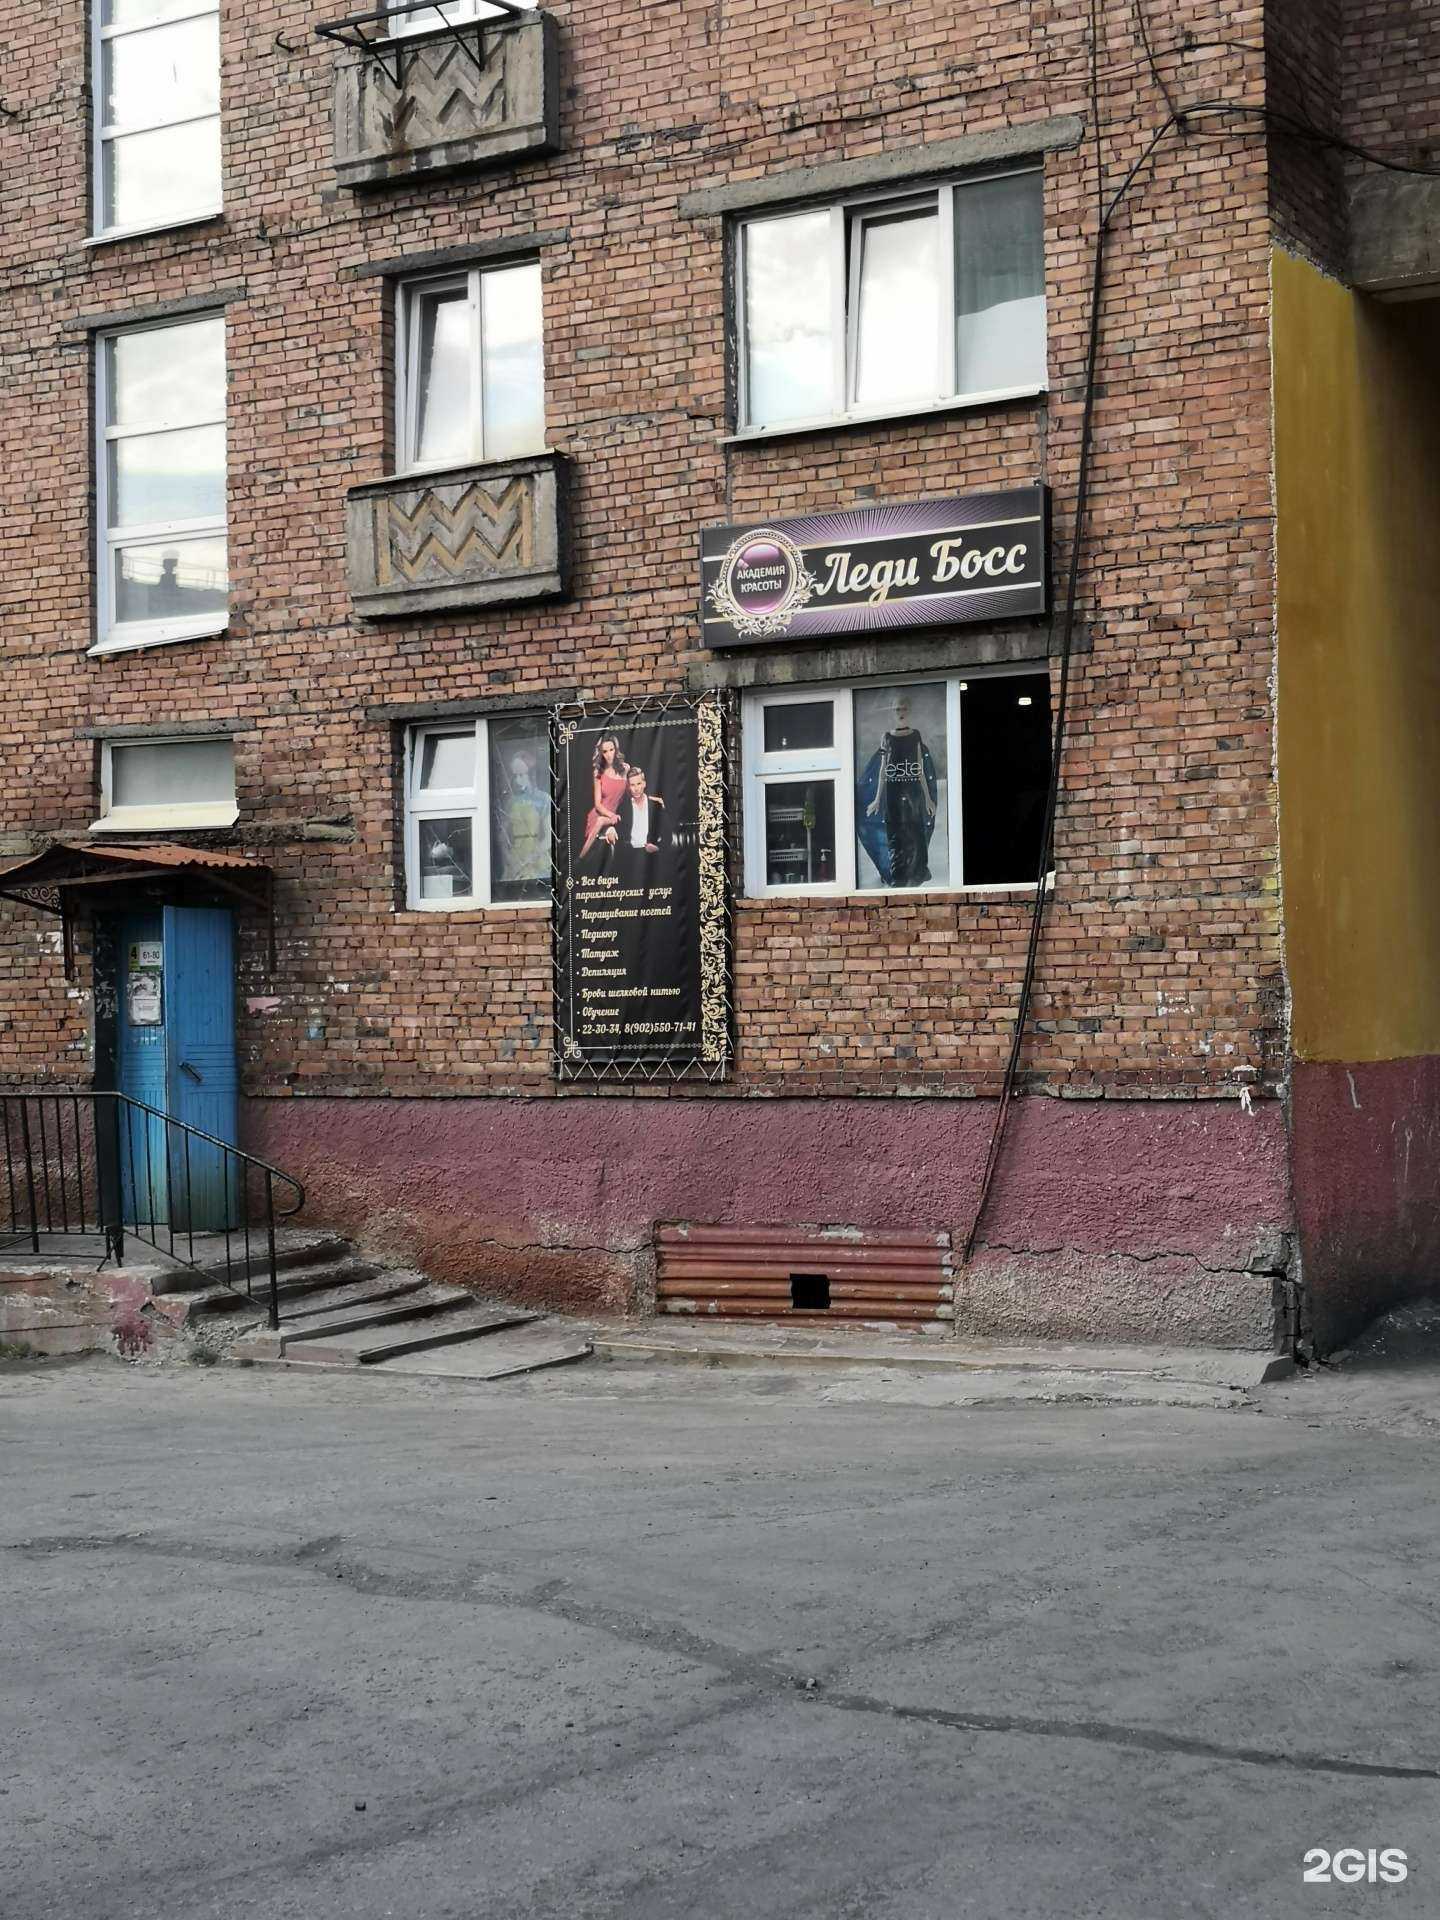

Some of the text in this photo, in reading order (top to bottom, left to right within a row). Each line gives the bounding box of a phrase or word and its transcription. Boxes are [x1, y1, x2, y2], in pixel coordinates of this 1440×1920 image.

[736, 565, 786, 580] АКАДЕМИЯ
[813, 537, 1027, 607] Леди Босс
[740, 579, 782, 593] КРАСОТЫ
[885, 759, 924, 778] estel
[581, 876, 618, 888] Все виды
[576, 887, 673, 902] парикмахерских услуг
[581, 905, 672, 922] Наращивание ногтей
[581, 929, 618, 942] Педикюр
[131, 947, 137, 959] 4
[581, 948, 620, 961] Татуаж
[581, 966, 627, 978] Депиляция
[581, 986, 681, 1002] Брови шелковой нитью
[582, 1007, 620, 1020] Обучение
